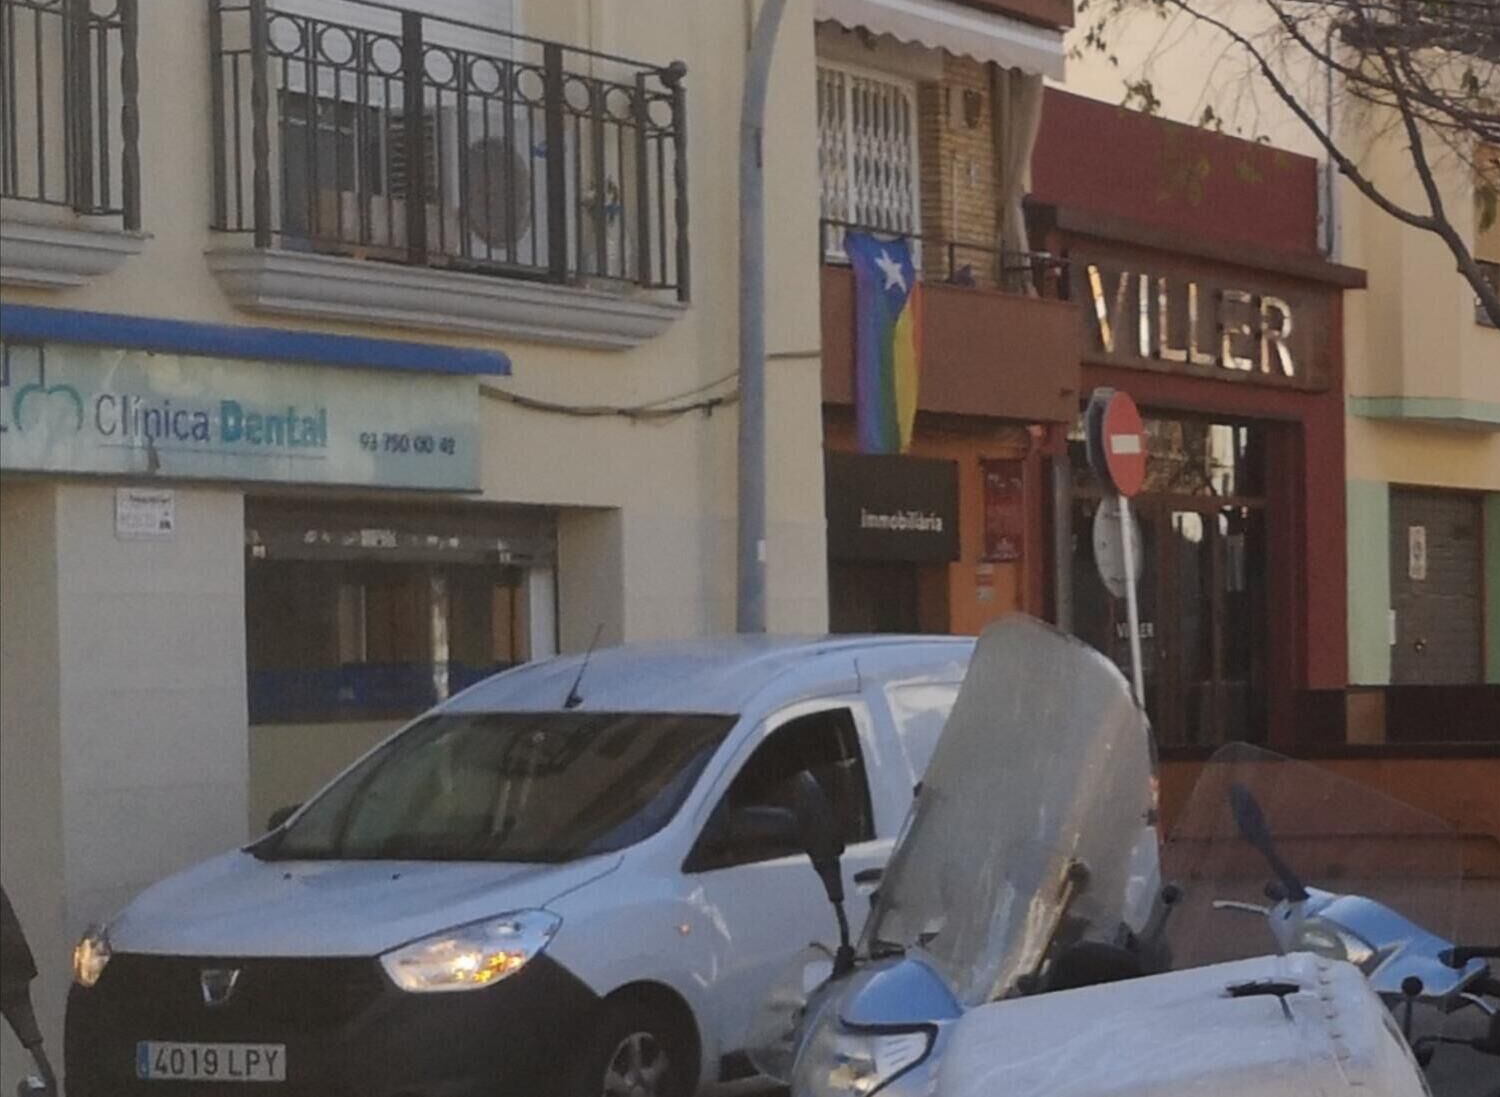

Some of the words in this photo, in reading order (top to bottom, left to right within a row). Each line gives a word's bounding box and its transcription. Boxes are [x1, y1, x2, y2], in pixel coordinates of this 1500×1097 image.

[1087, 264, 1295, 377] VILLER
[95, 393, 210, 442] Clínica
[219, 399, 328, 449] Dental
[155, 1048, 219, 1076] 4019
[229, 1049, 279, 1077] LPY
